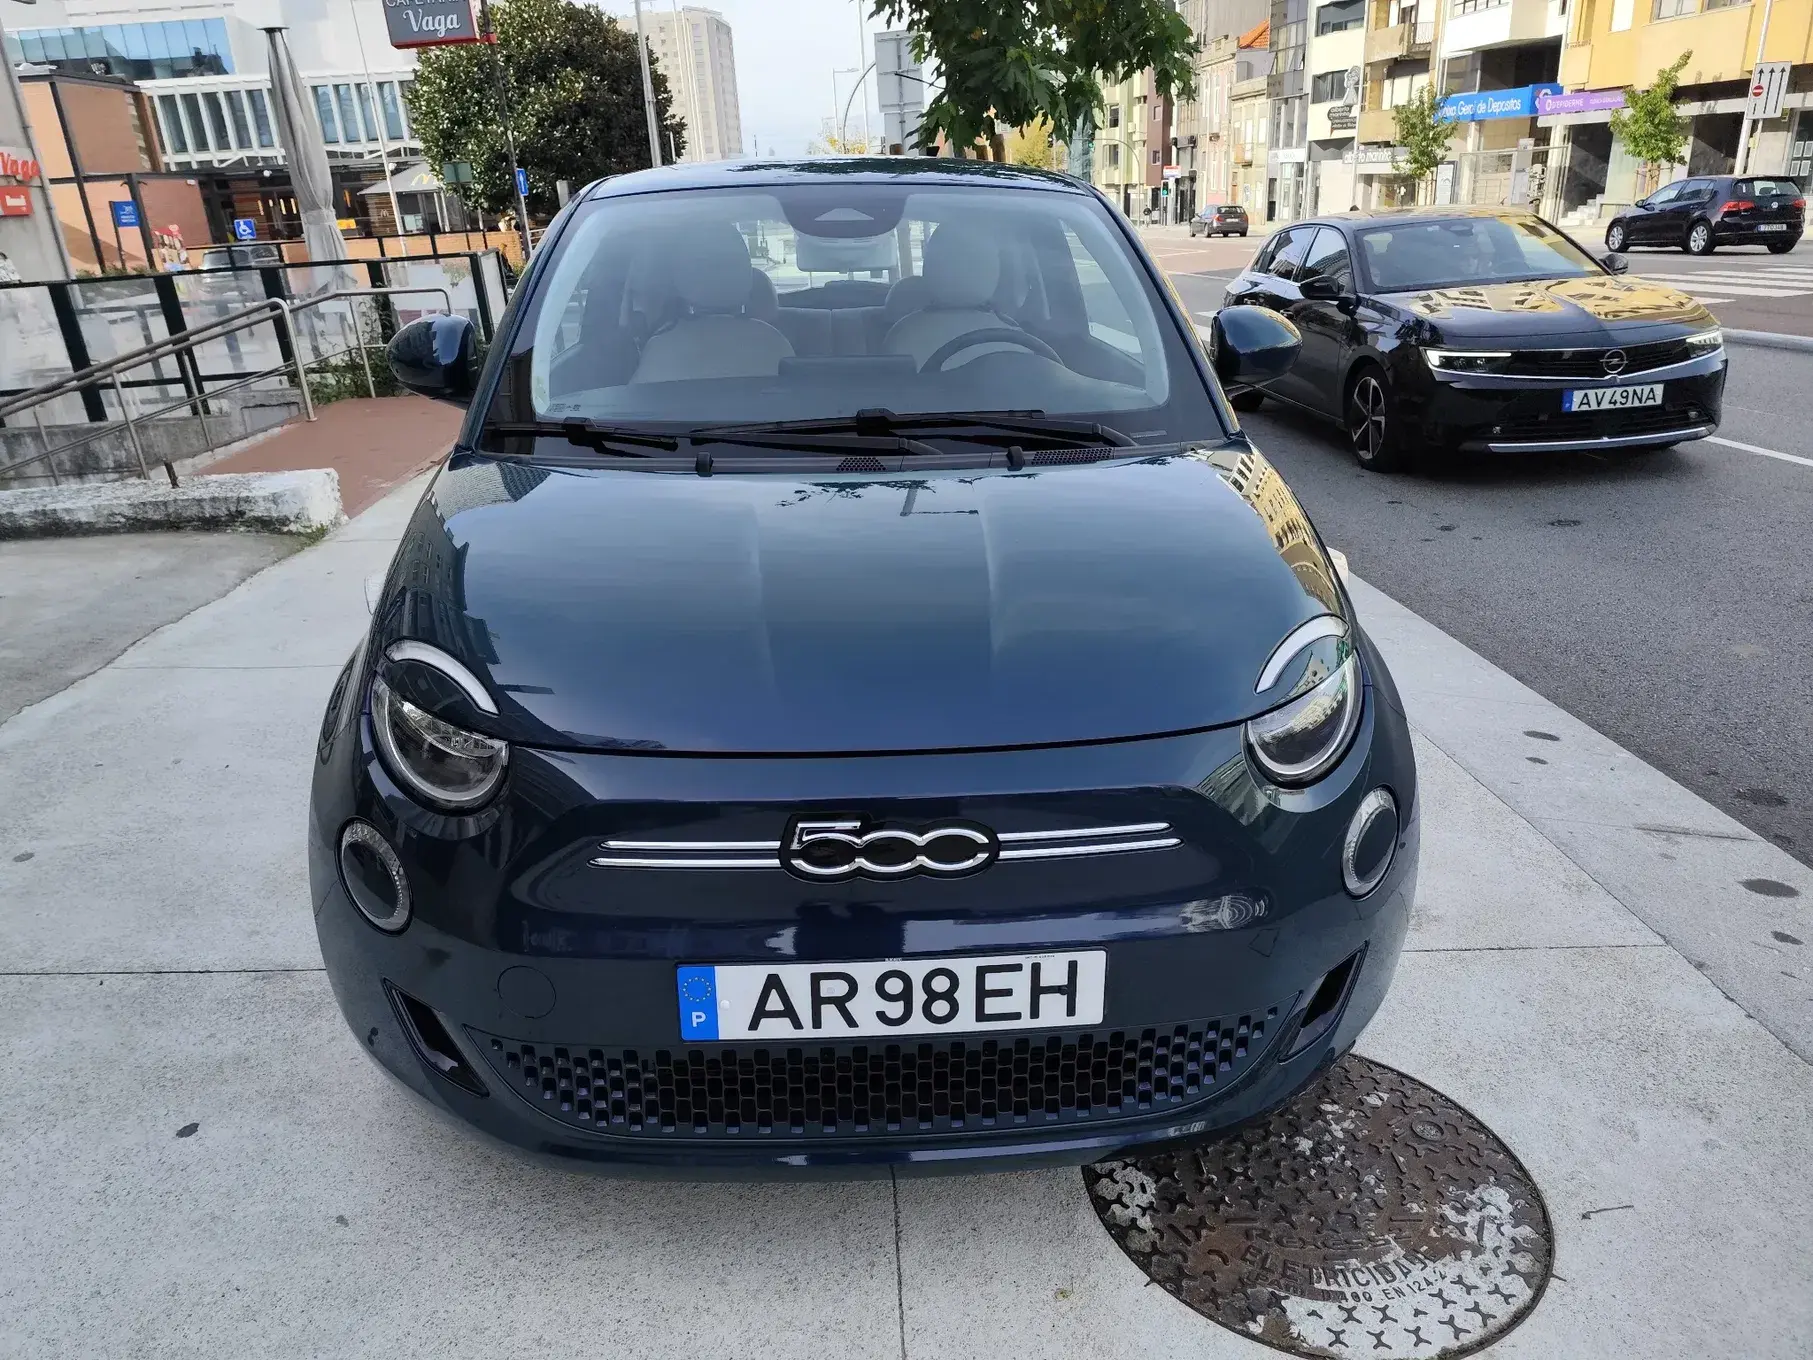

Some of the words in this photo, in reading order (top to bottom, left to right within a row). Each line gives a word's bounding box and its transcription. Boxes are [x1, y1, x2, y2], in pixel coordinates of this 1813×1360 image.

[403, 9, 461, 37] Vaga
[1477, 99, 1486, 114] de
[0, 152, 40, 181] Vaga
[790, 820, 990, 875] 500
[692, 1011, 707, 1028] P
[1240, 1244, 1446, 1287] ELETRICIDADE
[1382, 1284, 1406, 1300] EN
